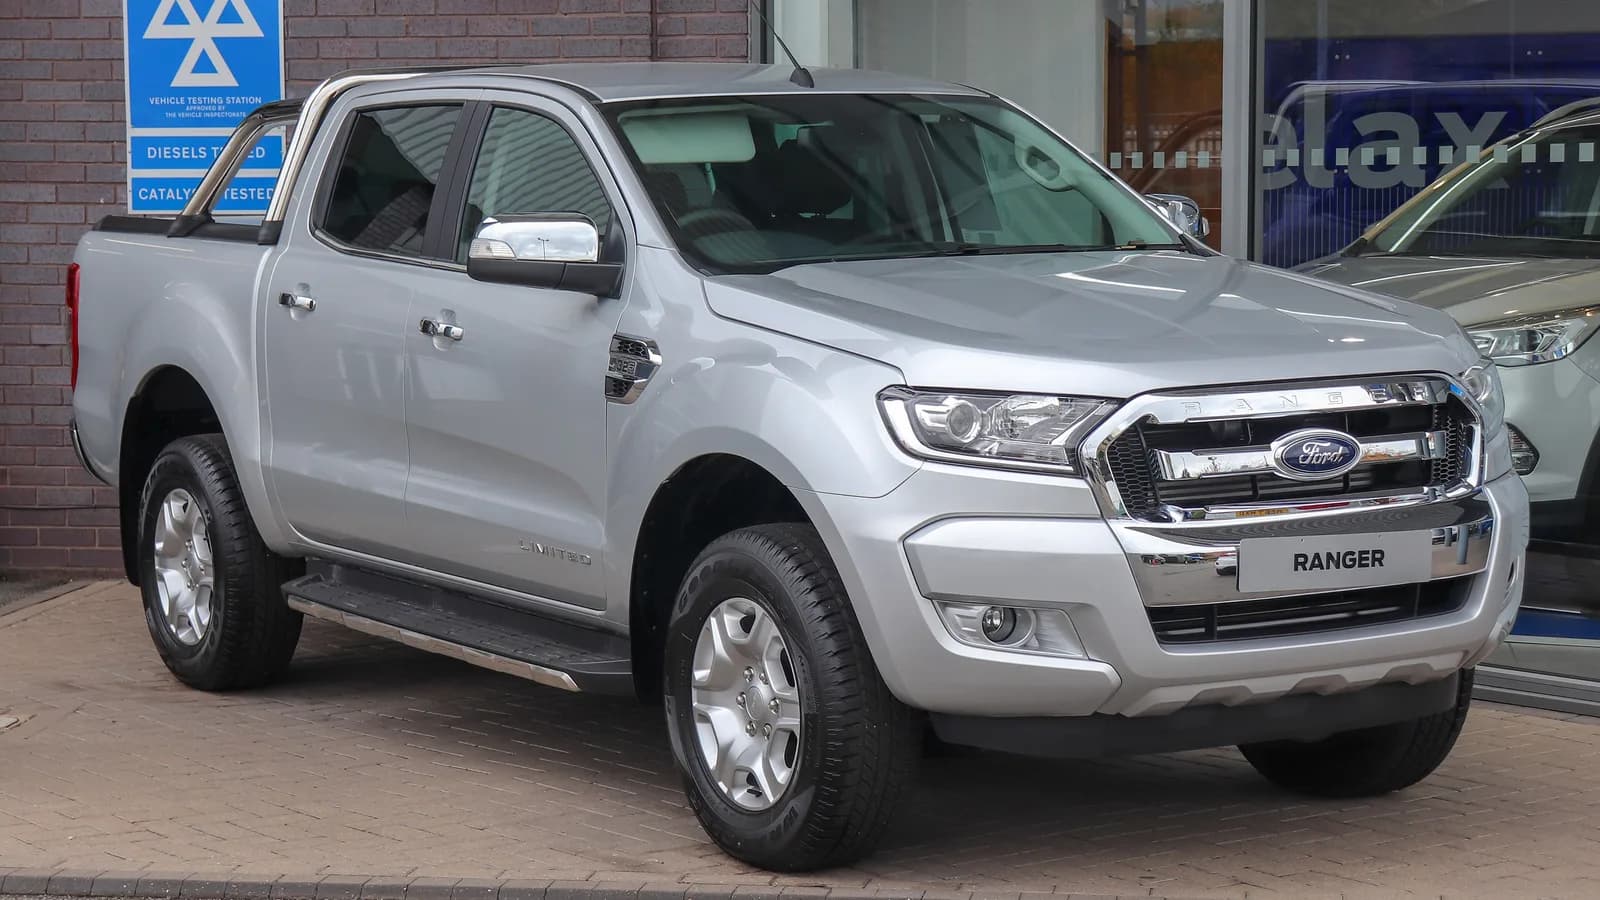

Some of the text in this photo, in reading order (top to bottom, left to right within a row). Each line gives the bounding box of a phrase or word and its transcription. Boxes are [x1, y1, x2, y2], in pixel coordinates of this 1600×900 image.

[149, 96, 262, 105] VEHICLE TESTING STATION
[147, 147, 207, 159] DIESELS
[224, 188, 273, 200] TESTED
[1181, 384, 1428, 415] RANGER
[1299, 441, 1344, 466] Ford
[520, 540, 592, 566] LIMITED
[1293, 550, 1385, 571] RANGER
